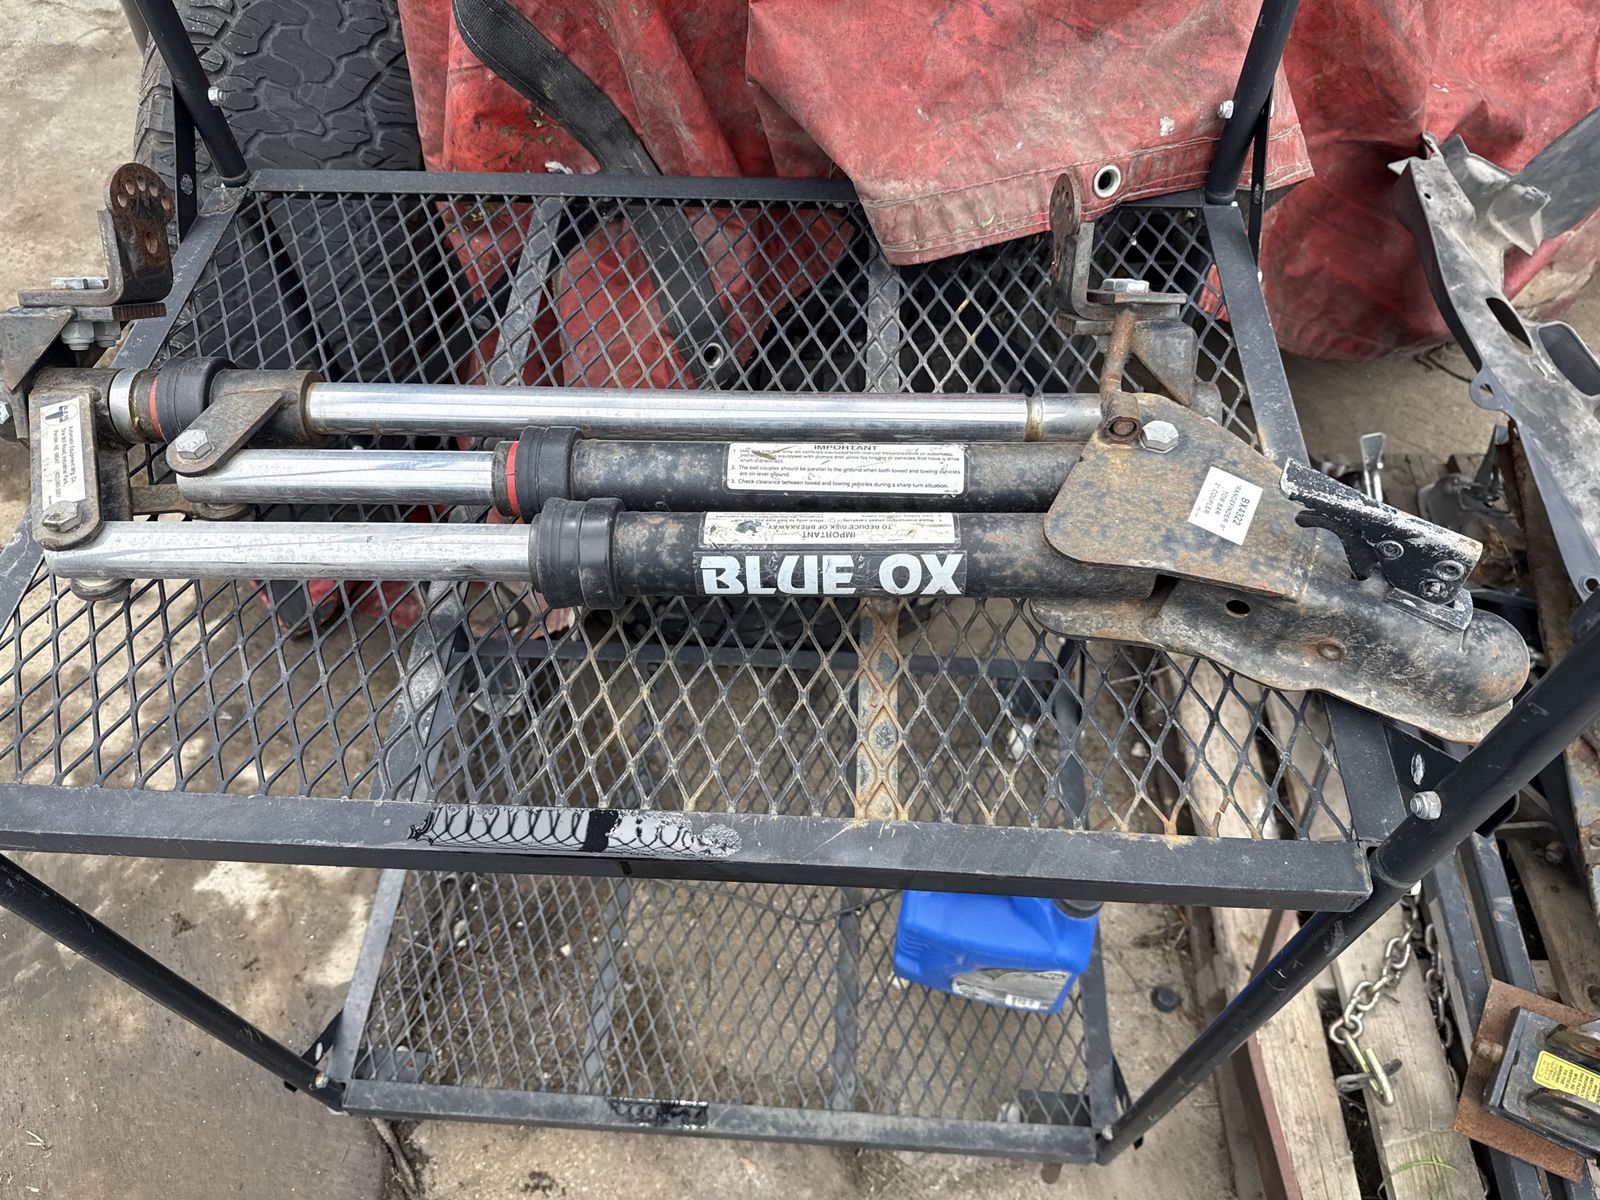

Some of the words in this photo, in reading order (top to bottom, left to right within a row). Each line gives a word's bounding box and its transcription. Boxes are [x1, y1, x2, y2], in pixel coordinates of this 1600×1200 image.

[1203, 489, 1218, 514] COUPLER
[1215, 503, 1223, 514] BAR
[1220, 490, 1228, 502] TOW
[1233, 497, 1250, 526] BX4322
[700, 555, 856, 595] BLUE
[879, 553, 963, 595] OX
